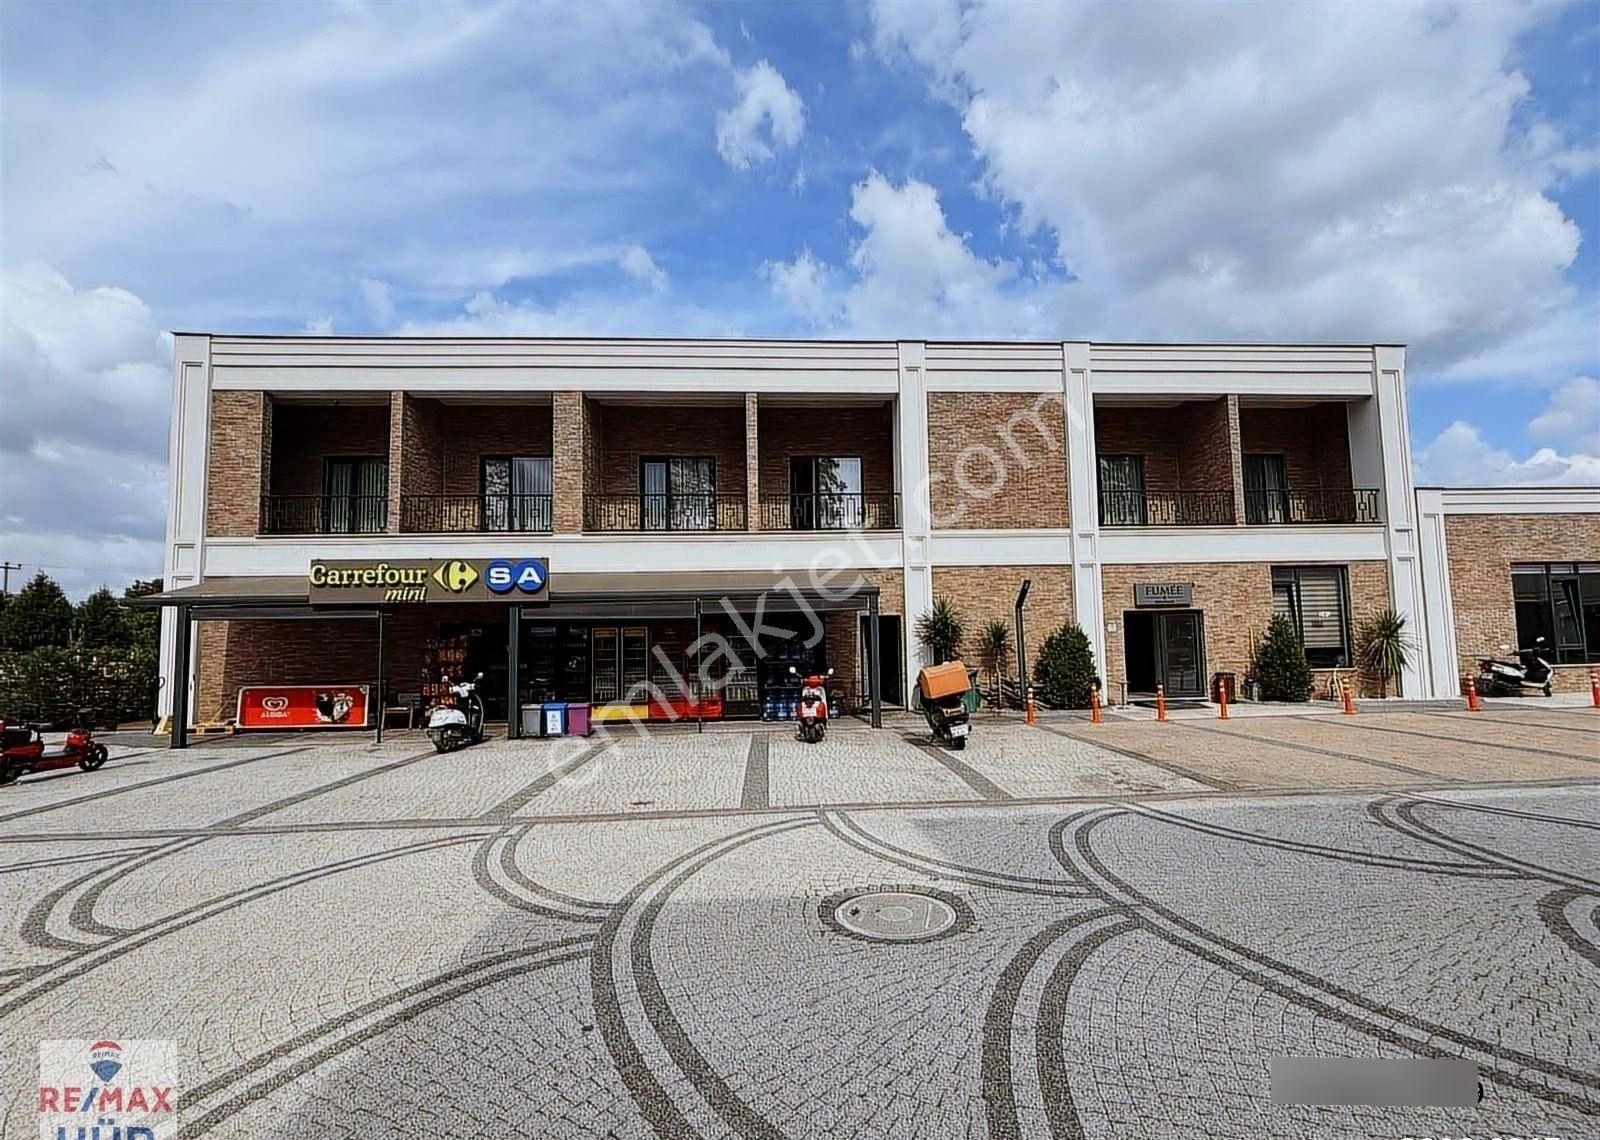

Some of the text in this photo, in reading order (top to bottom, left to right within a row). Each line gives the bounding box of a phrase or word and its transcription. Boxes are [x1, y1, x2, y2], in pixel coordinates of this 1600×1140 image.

[309, 564, 543, 586] Carrefour SA
[384, 586, 427, 602] mini
